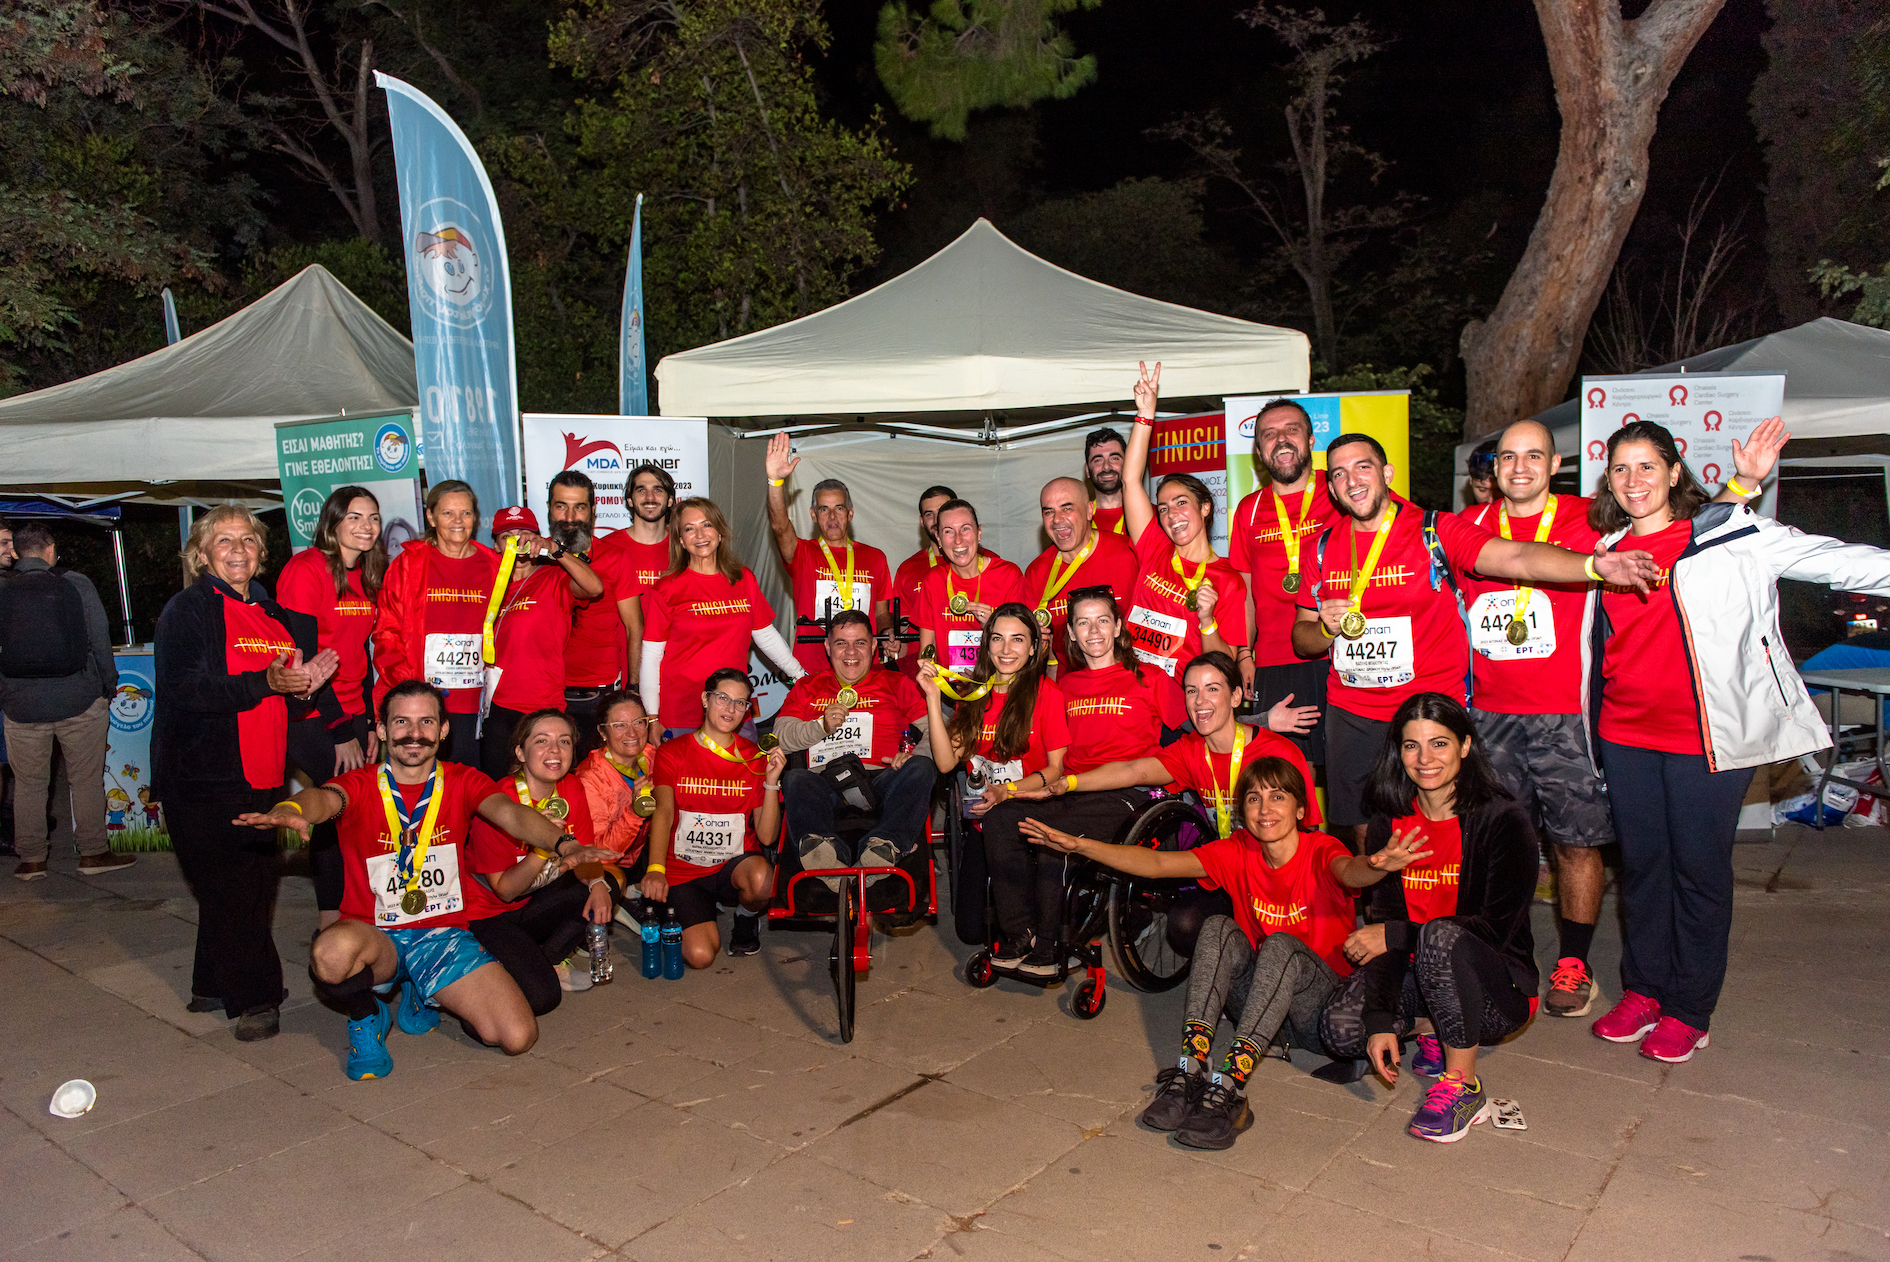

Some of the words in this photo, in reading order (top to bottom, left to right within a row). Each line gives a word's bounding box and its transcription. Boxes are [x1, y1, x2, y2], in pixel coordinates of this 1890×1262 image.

[1313, 422, 1330, 432] 23
[282, 438, 308, 454] ΕΙΣΑΙ
[310, 432, 364, 452] ΜΑΘΗΤΗΣ?
[1156, 426, 1219, 464] FINISH
[285, 461, 309, 477] ΓΙΝΕ
[311, 455, 373, 475] ΕΘΕΛΟΝΤΗΣ!
[587, 458, 620, 469] MDA
[595, 496, 624, 504] ΡΟΜΟΥ
[1212, 488, 1227, 497] 202
[1260, 526, 1284, 543] FINIS
[1376, 565, 1406, 587] LINE
[427, 588, 457, 602] FINISH
[462, 589, 482, 603] LINE
[692, 600, 728, 615] FINISH
[729, 599, 750, 614] LINE
[1481, 611, 1536, 632] 4421
[1132, 626, 1171, 651] 34490
[436, 652, 479, 665] 44279
[1346, 641, 1397, 660] 44247
[1068, 698, 1096, 717] FINISH
[1099, 697, 1125, 715] LINE
[680, 777, 717, 795] FINISH
[722, 780, 746, 797] LINE
[686, 831, 732, 845] 44331
